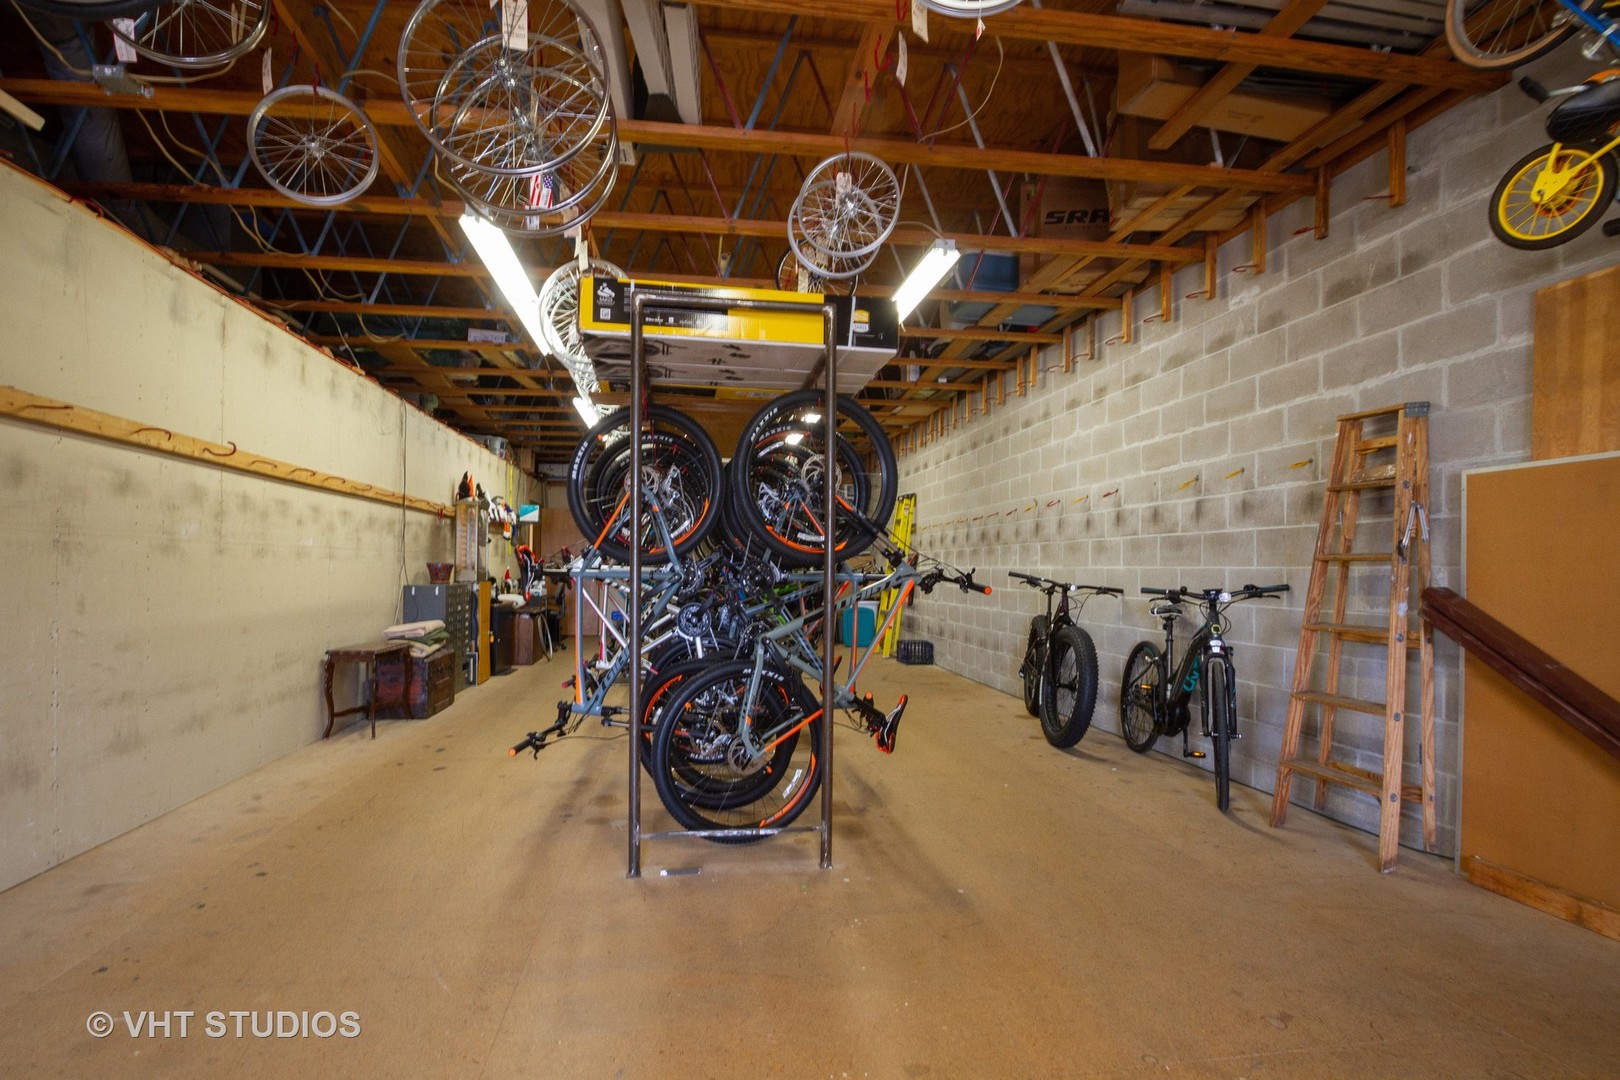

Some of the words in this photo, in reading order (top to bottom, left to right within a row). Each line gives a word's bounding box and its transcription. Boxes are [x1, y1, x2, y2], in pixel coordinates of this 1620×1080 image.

[1044, 208, 1110, 225] SRA
[750, 407, 778, 442] MAXXIS
[571, 440, 589, 480] MAXXIS
[742, 668, 785, 682] MXXIS
